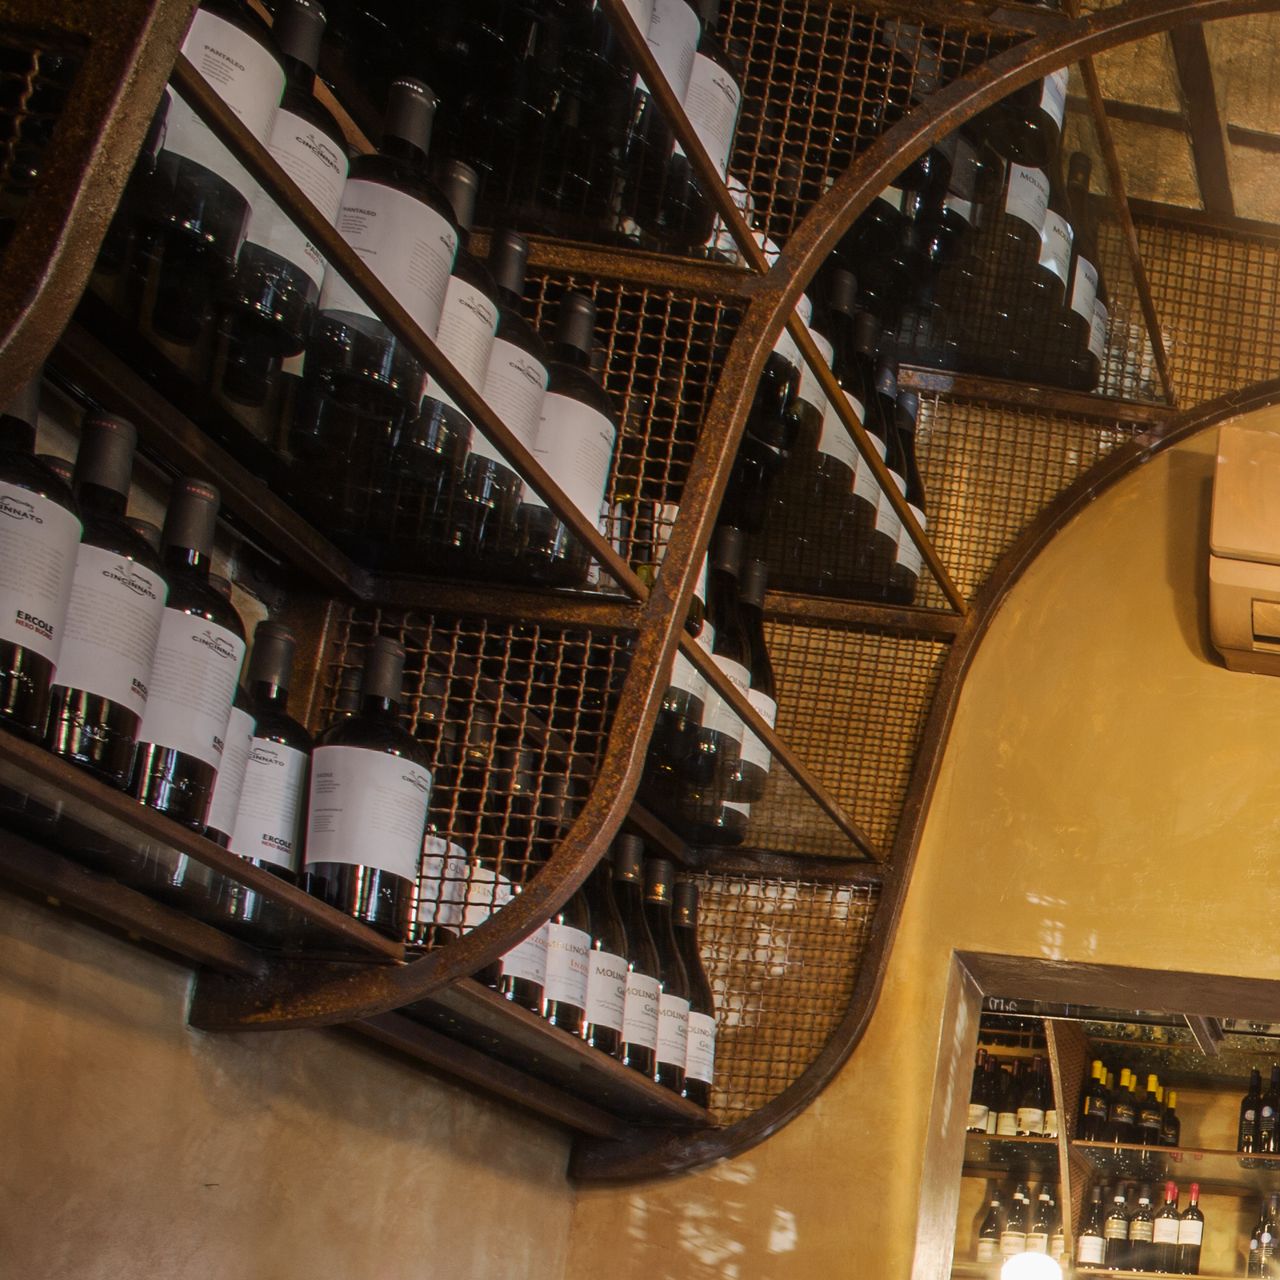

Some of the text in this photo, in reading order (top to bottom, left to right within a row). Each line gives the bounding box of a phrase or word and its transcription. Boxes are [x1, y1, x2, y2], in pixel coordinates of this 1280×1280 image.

[203, 44, 246, 72] PANTALEO
[295, 135, 341, 175] CINCINNATO
[102, 570, 156, 600] CINCINNATO
[16, 609, 54, 634] ERCOLE
[191, 634, 238, 662] CINCINNATO
[262, 832, 292, 849] ERCOLE
